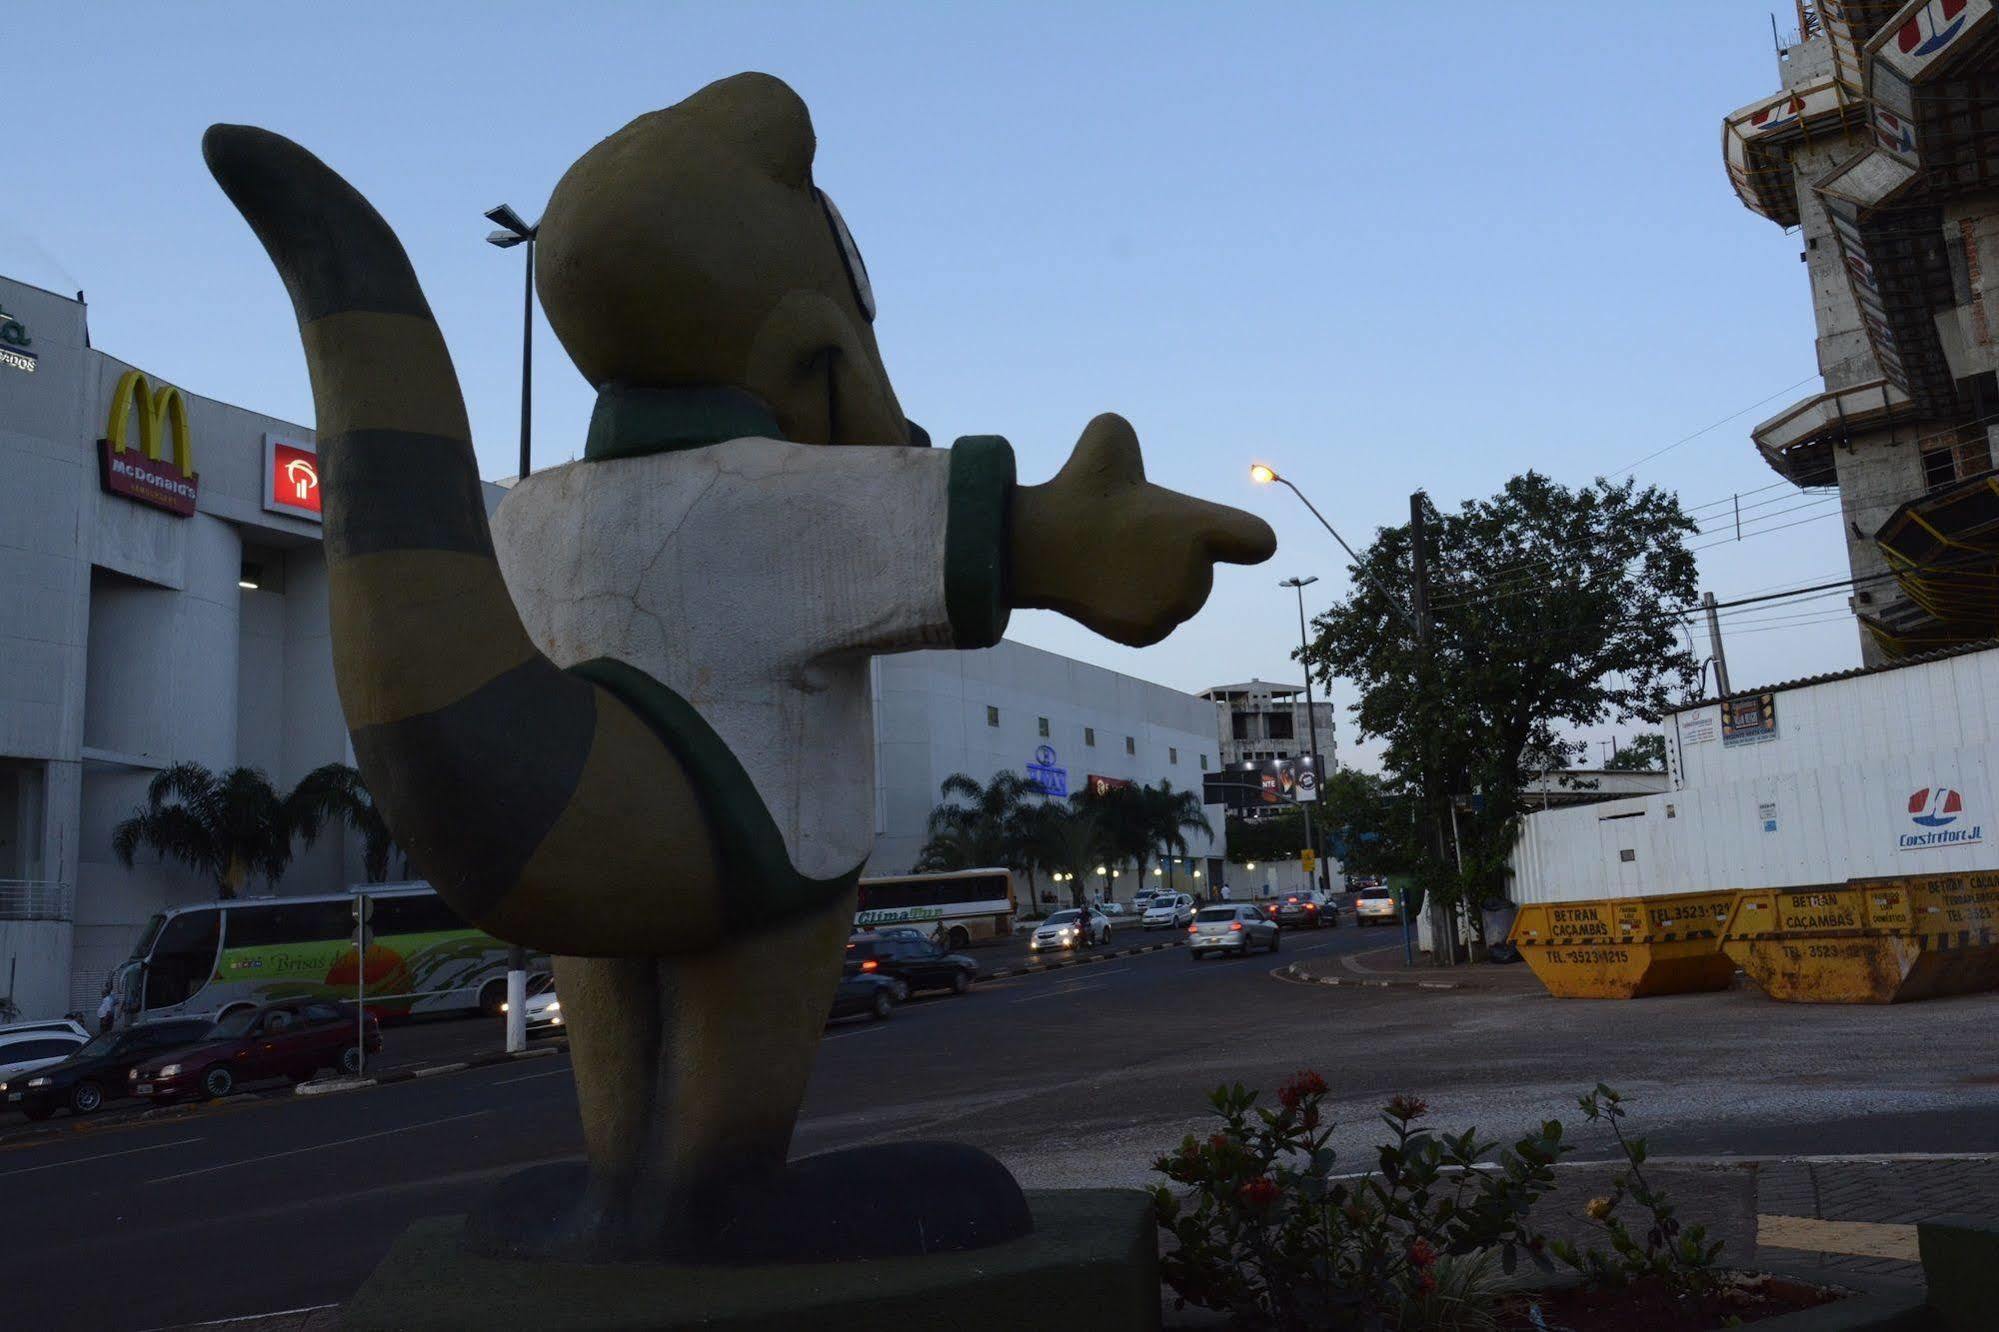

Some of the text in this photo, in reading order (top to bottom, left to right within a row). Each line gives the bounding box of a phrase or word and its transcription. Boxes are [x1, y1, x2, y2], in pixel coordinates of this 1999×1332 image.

[112, 459, 196, 499] McDonald's
[1553, 907, 1599, 923] BETRAN
[1786, 913, 1854, 930] CAÇAMBAS
[1552, 922, 1608, 939] CAÇAMBAS
